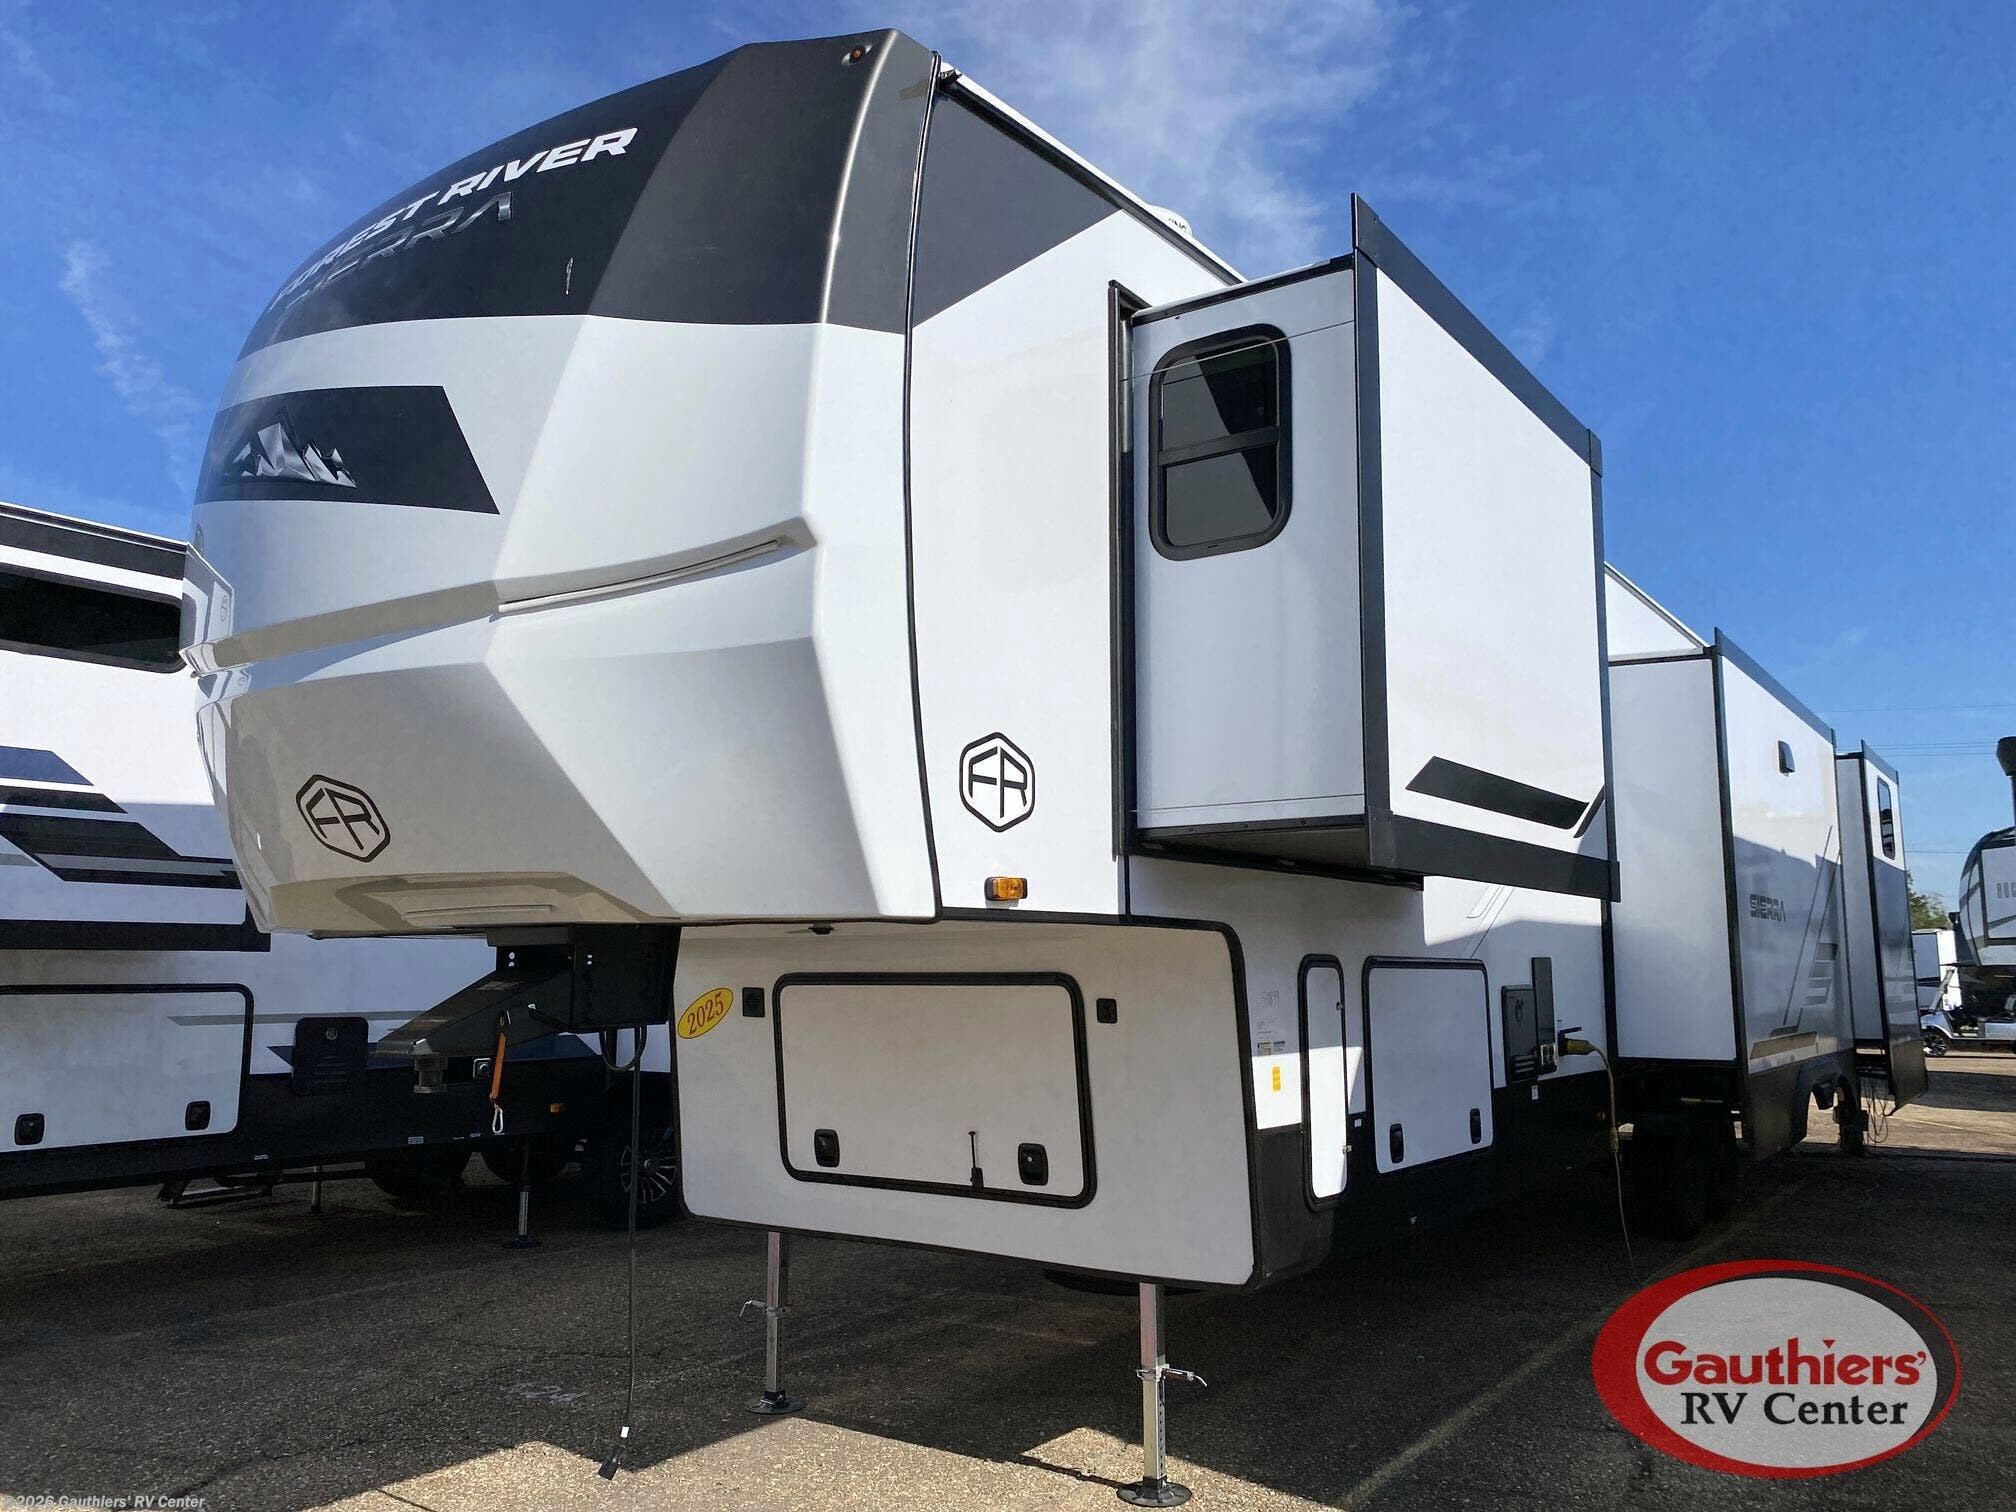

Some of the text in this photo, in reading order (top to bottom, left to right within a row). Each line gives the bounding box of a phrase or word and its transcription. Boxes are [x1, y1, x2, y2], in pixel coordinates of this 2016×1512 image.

[437, 127, 638, 206] RIVER
[1750, 893, 1787, 922] SIERRA
[687, 990, 724, 1036] 2025
